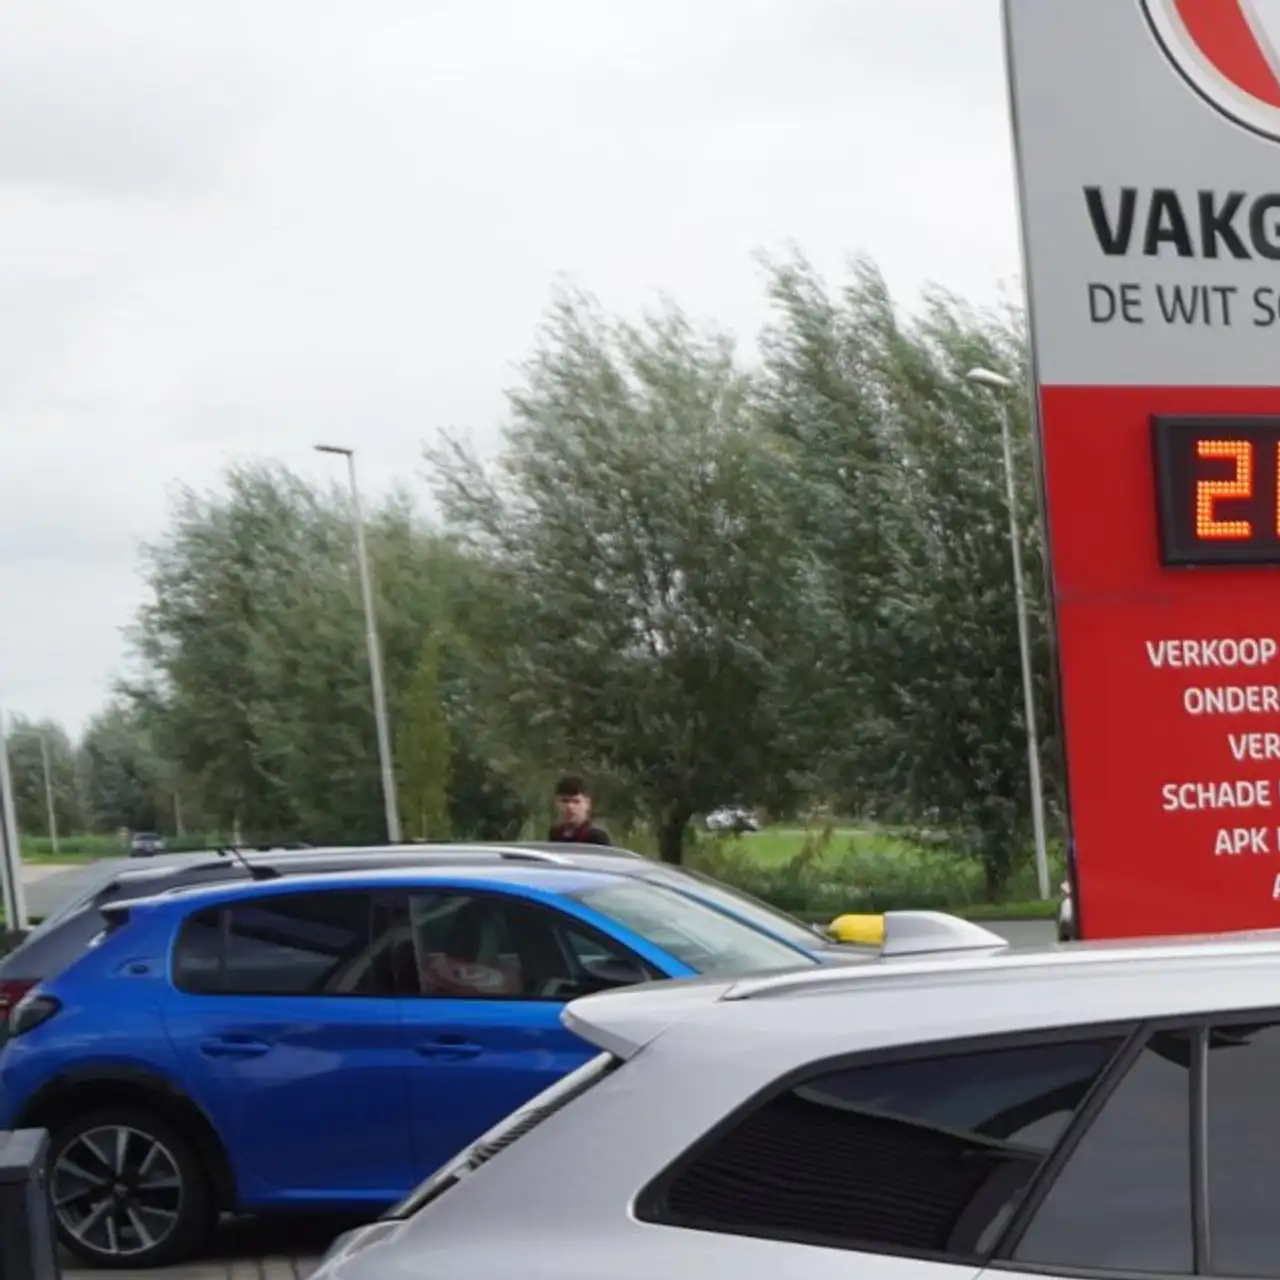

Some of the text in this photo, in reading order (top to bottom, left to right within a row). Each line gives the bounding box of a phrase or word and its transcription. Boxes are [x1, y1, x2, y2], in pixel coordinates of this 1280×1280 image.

[1087, 283, 1144, 324] DE
[1155, 285, 1238, 326] WIT
[1146, 638, 1277, 668] VERKOOP
[1162, 780, 1272, 812] SCHADE
[1214, 827, 1270, 857] APK
